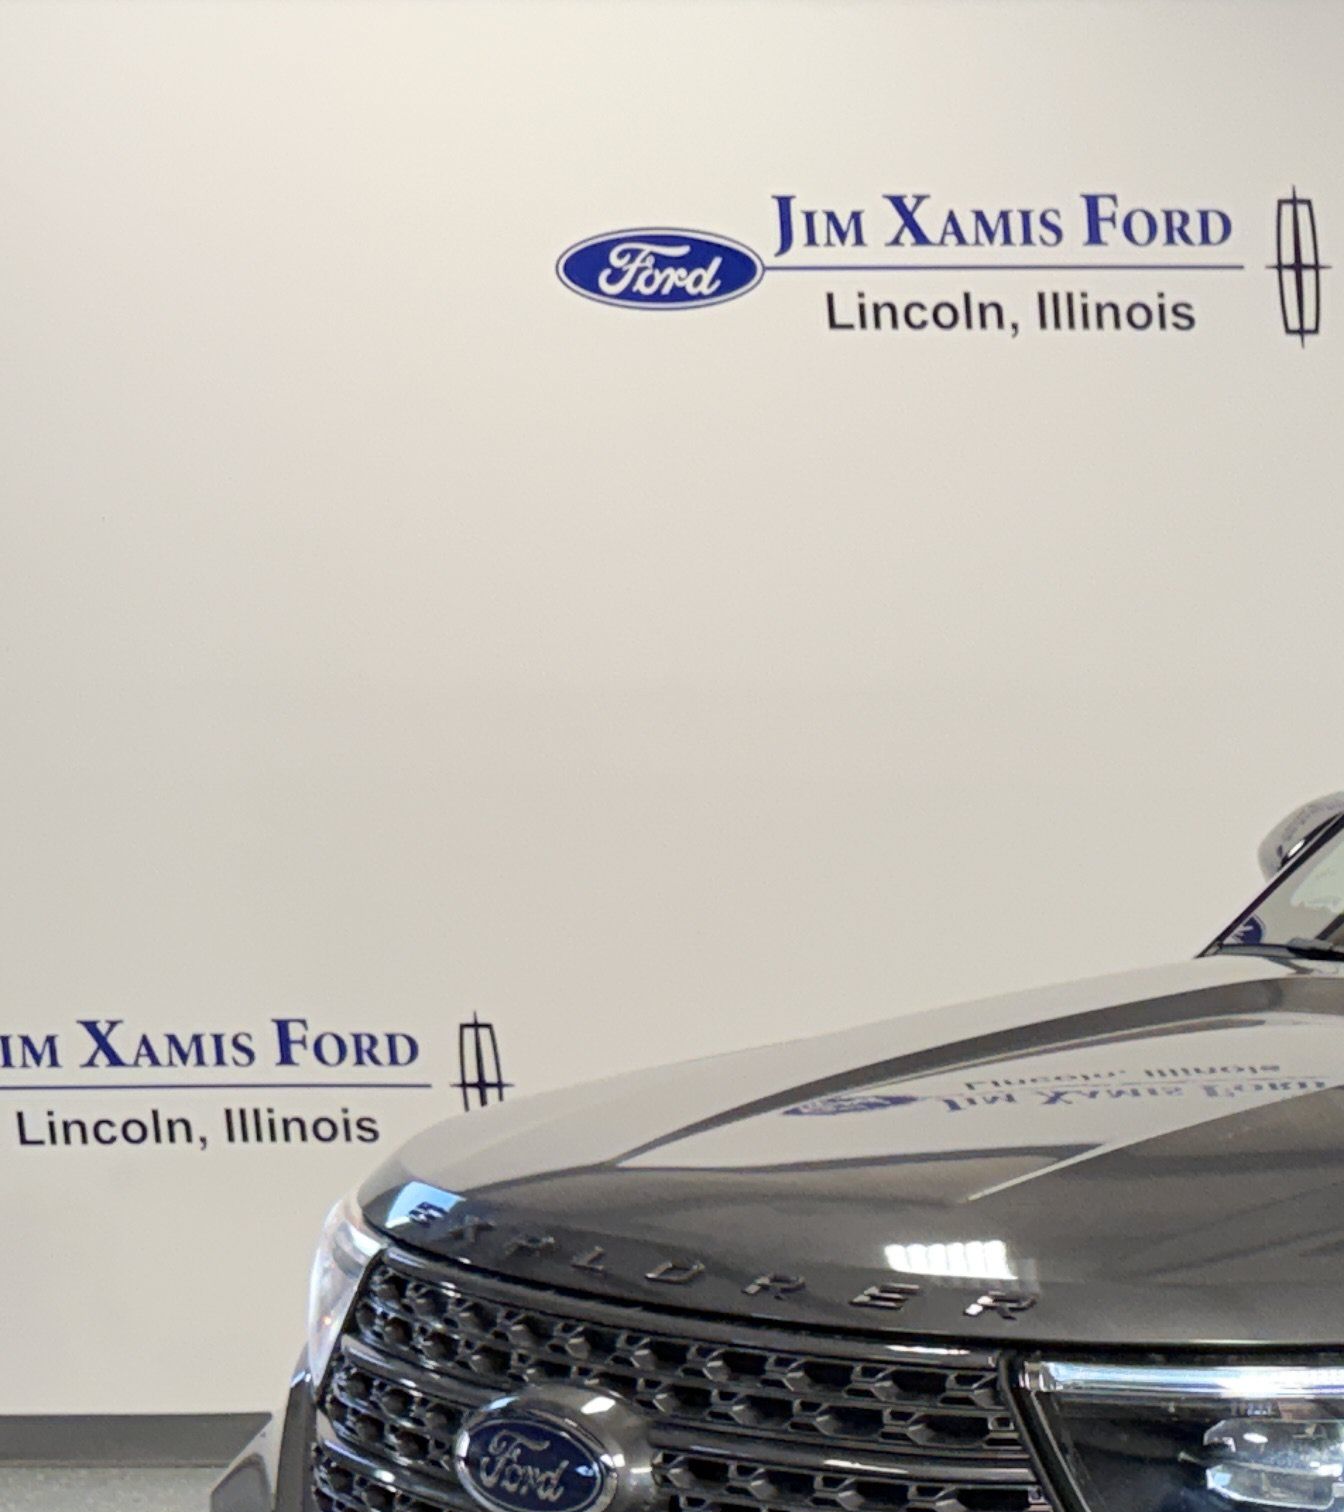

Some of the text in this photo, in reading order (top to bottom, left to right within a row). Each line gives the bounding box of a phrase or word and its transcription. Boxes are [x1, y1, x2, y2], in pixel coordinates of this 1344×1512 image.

[771, 193, 1233, 257] JIM XAMIS FORD
[597, 241, 723, 299] Ford
[826, 291, 1196, 336] Lincoln, Illinois
[0, 1018, 420, 1069] IM XAMIS FORD
[16, 1107, 381, 1150] Lincoln, Illinois
[480, 1429, 570, 1502] Ford
